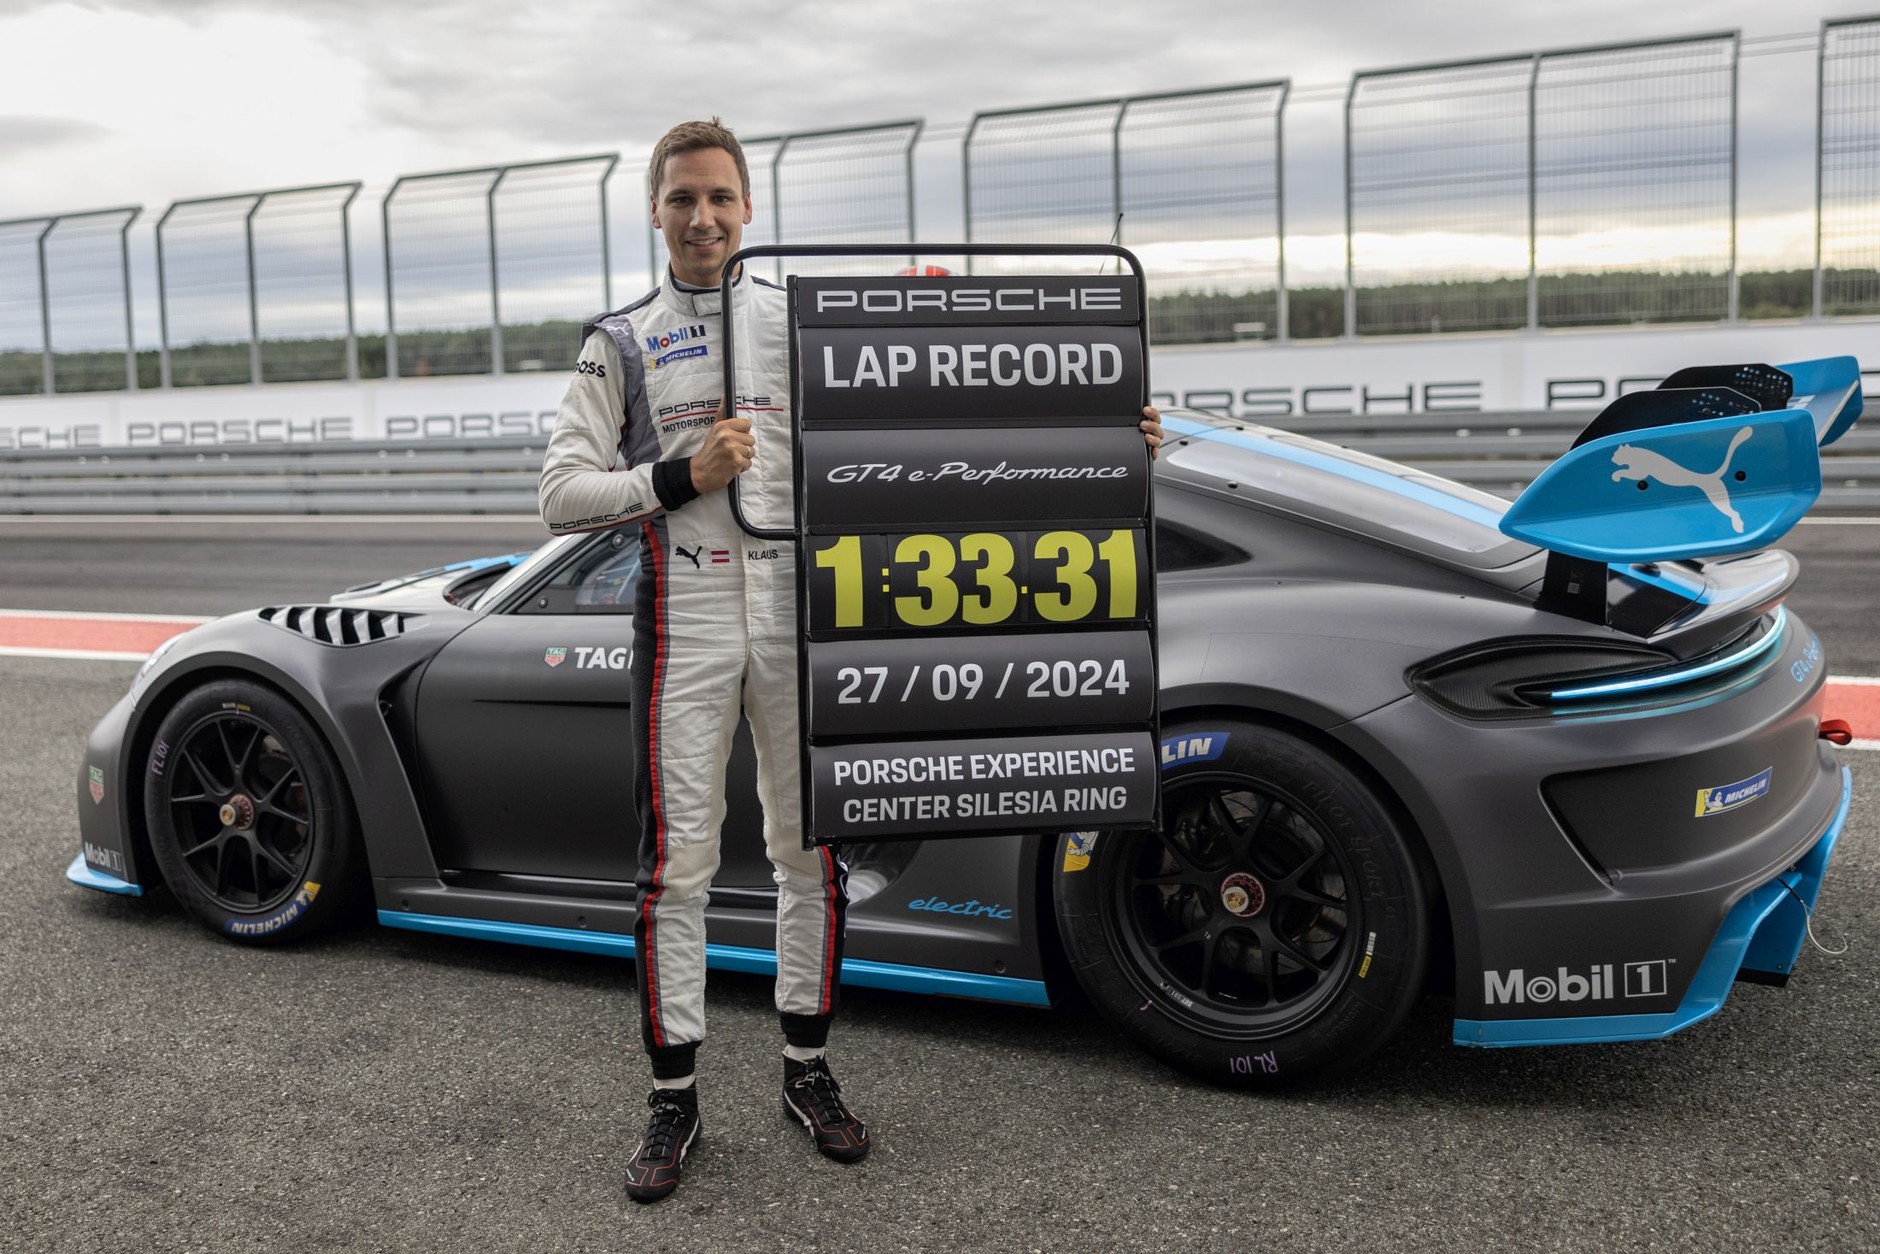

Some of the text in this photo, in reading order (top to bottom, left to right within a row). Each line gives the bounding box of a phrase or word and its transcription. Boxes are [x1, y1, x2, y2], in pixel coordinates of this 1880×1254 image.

[817, 288, 1121, 312] PORSCHE
[646, 327, 688, 351] Mobil
[666, 349, 702, 361] MICHELIN
[823, 343, 1123, 388] LAP RECORD
[127, 417, 352, 446] PORSCHE
[827, 461, 1128, 485] GT4 e-Performance
[550, 502, 644, 530] PORSCHE
[748, 549, 778, 560] KLAUS
[815, 529, 1137, 628] 1:33.31
[837, 659, 1130, 704] 27 / 09 / 2024
[834, 748, 1135, 786] PORSCHE EXPERIENCE
[843, 786, 1128, 823] CENTER SILESIA RING
[1724, 778, 1767, 804] MICHELIN
[85, 842, 111, 868] Mobil
[231, 904, 298, 934] MICHELIN
[908, 896, 1012, 919] electric
[1484, 964, 1613, 1004] Mobil
